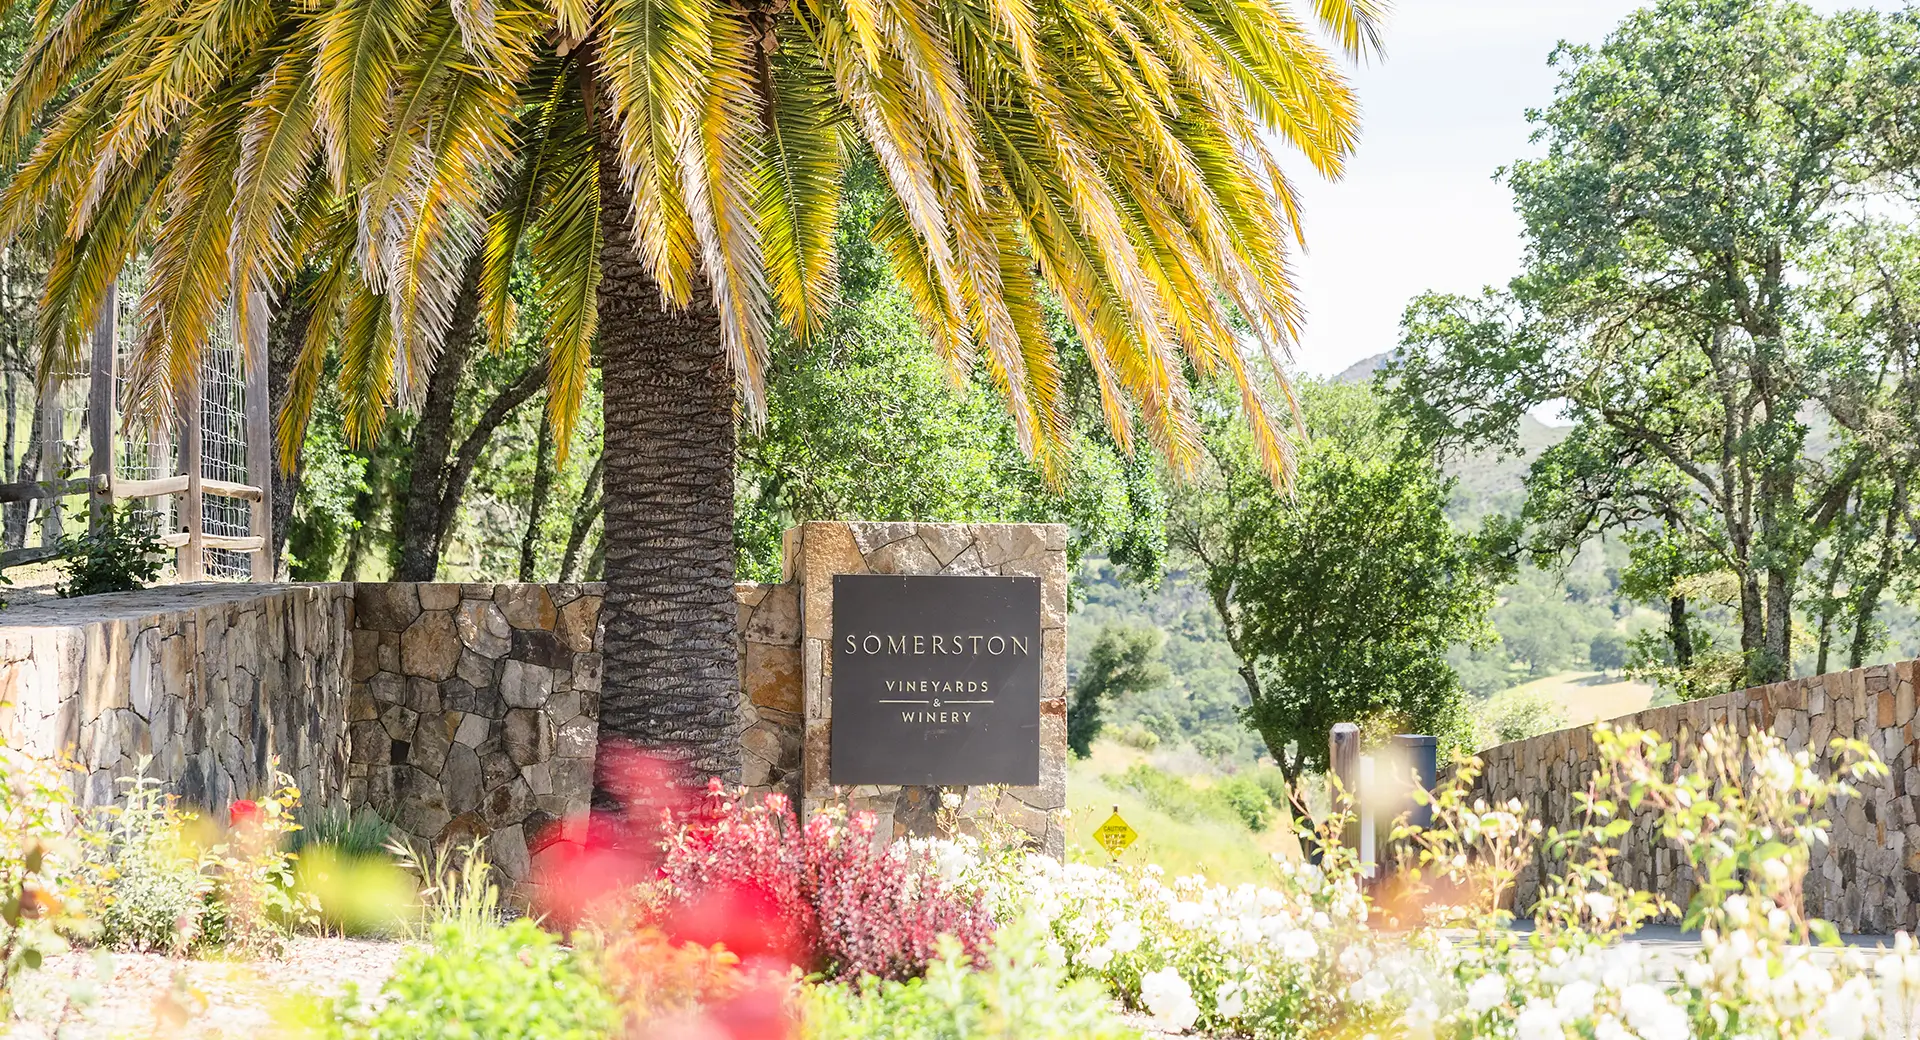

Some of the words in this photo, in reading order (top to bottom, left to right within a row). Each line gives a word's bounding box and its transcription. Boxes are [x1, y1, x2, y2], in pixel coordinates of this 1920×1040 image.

[845, 634, 1029, 656] SOMERSTON
[885, 680, 989, 693] VINEYARDS
[933, 698, 941, 708] &
[902, 711, 972, 723] WINERY
